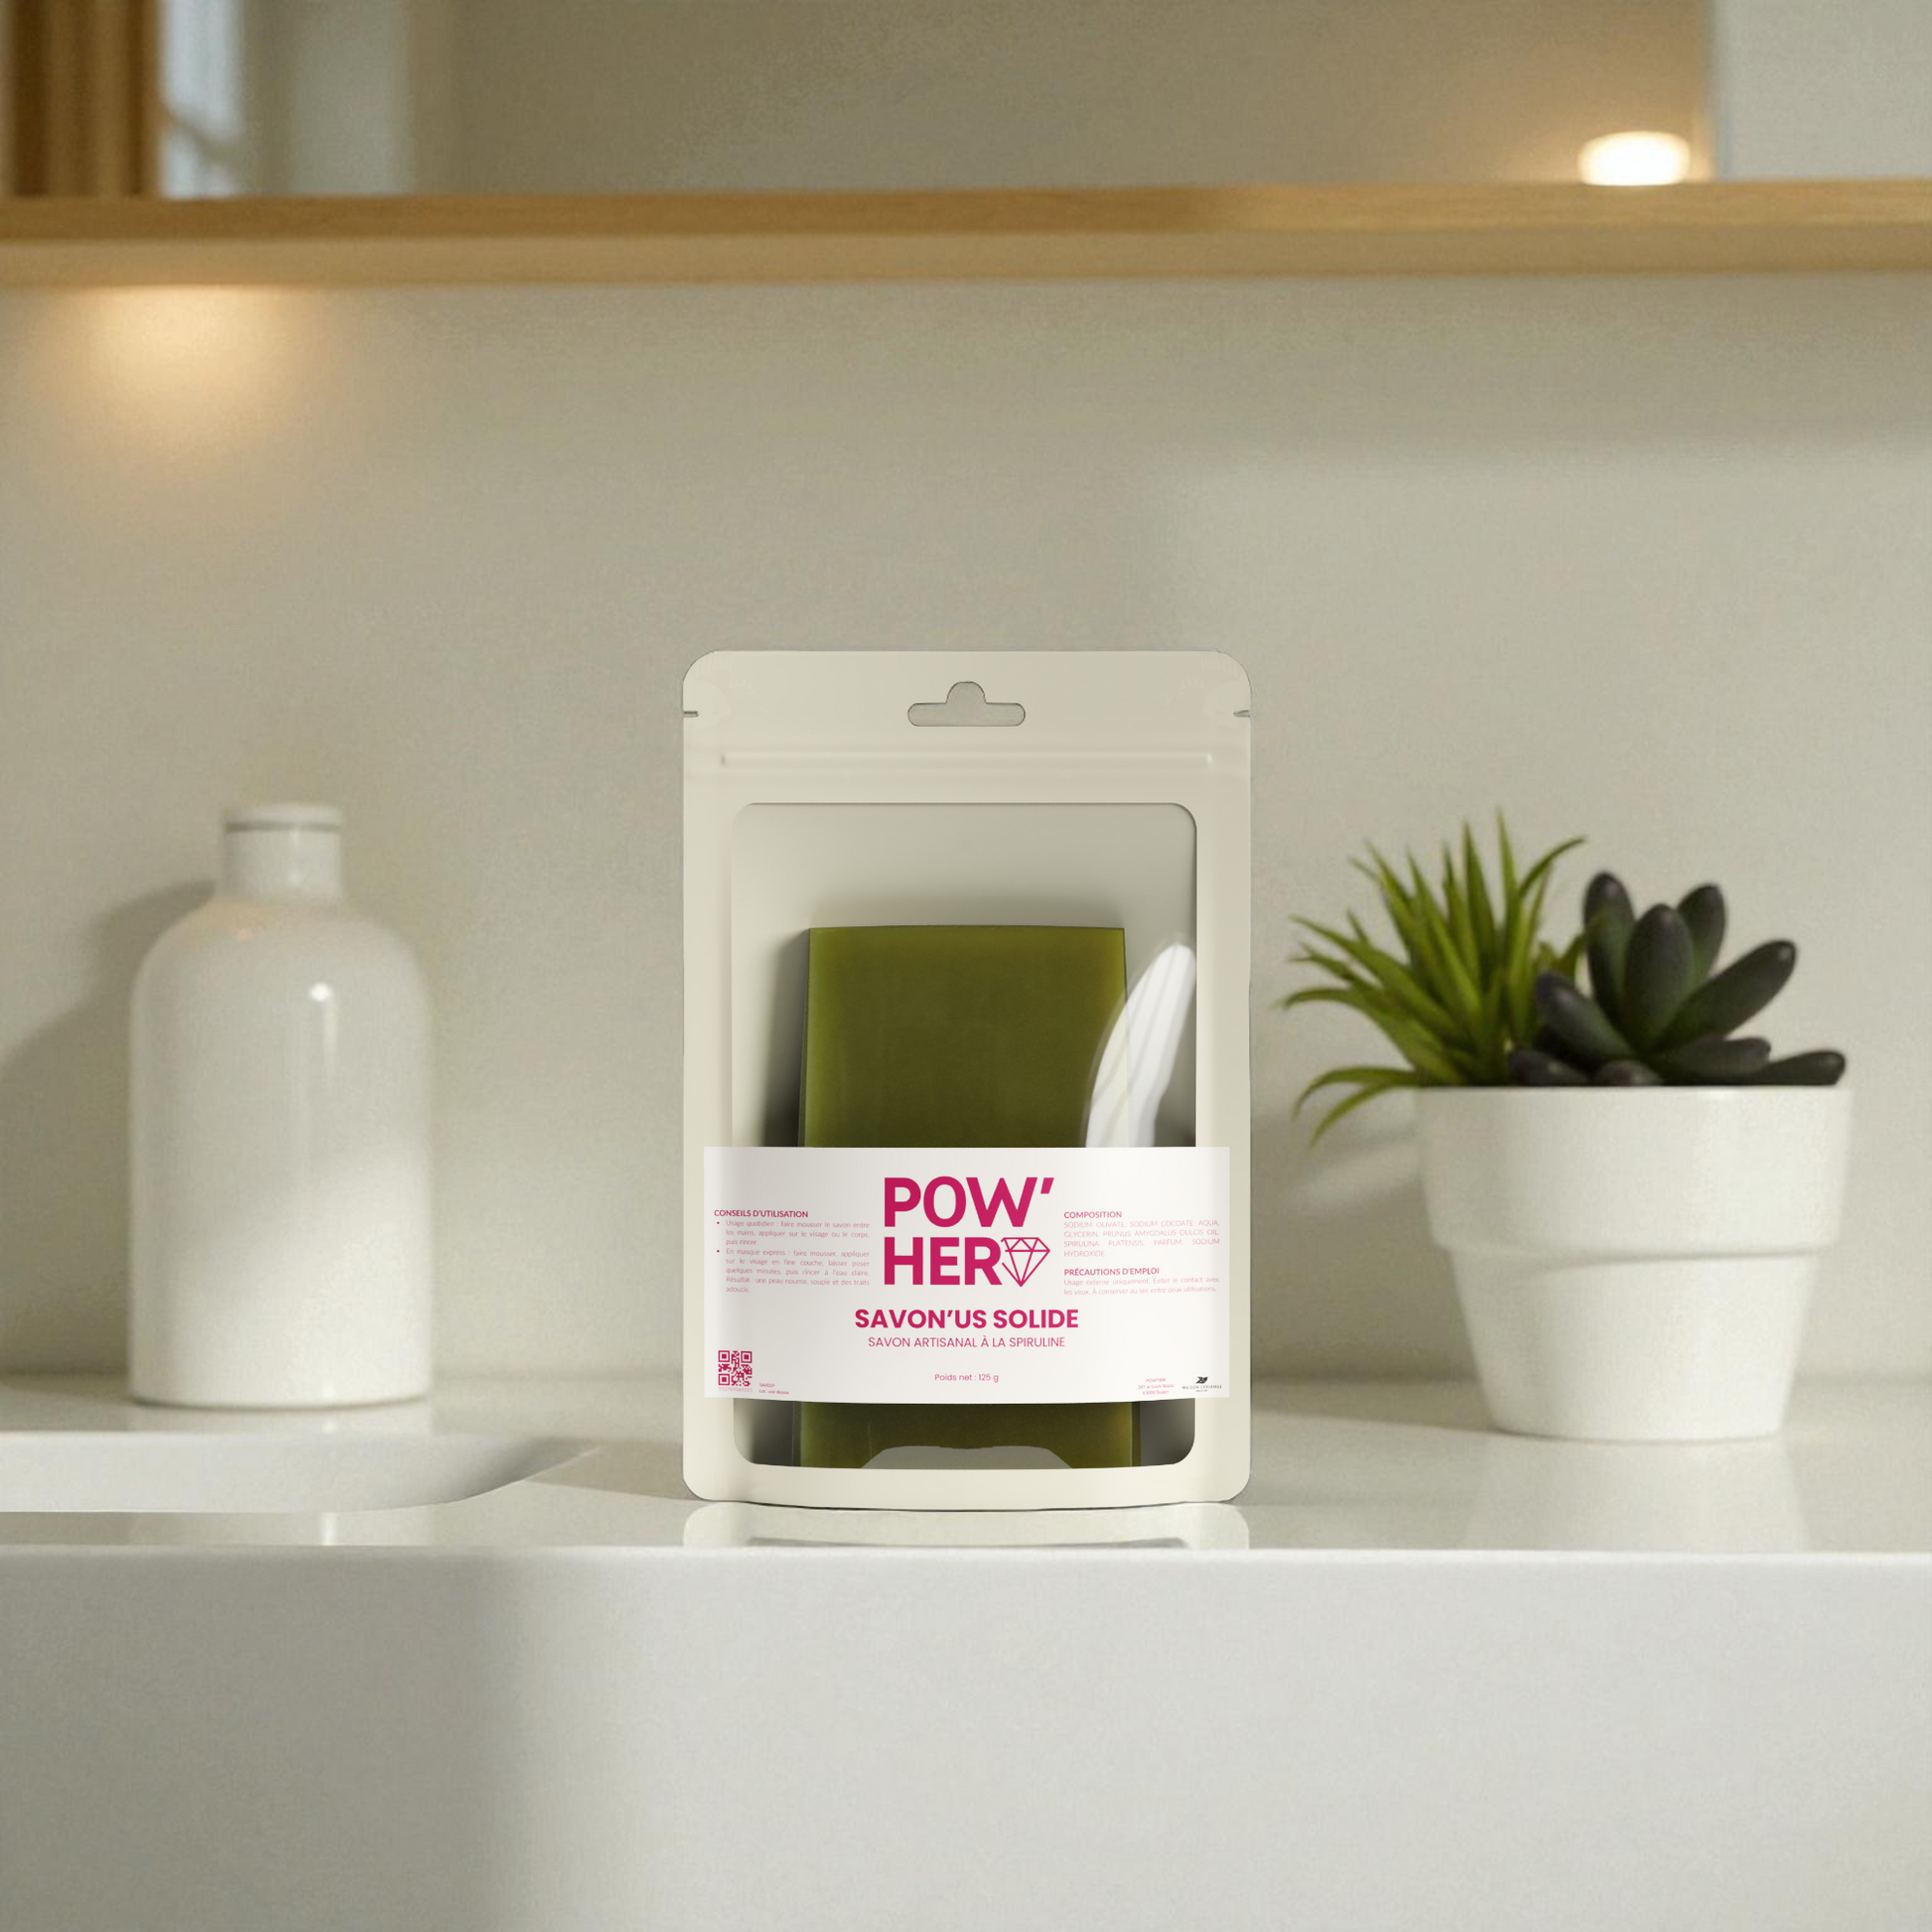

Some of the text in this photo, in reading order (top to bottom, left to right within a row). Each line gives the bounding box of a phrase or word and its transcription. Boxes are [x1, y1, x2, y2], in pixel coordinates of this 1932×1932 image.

[884, 1176, 1054, 1228] POW'
[884, 1237, 1002, 1285] HER
[1064, 1267, 1120, 1276] PRÉCAUTIONS
[855, 1309, 1079, 1329] SAVON'US SOLIDE
[868, 1335, 1065, 1348] SAVON ARTISANAL À LA SPIRULINE
